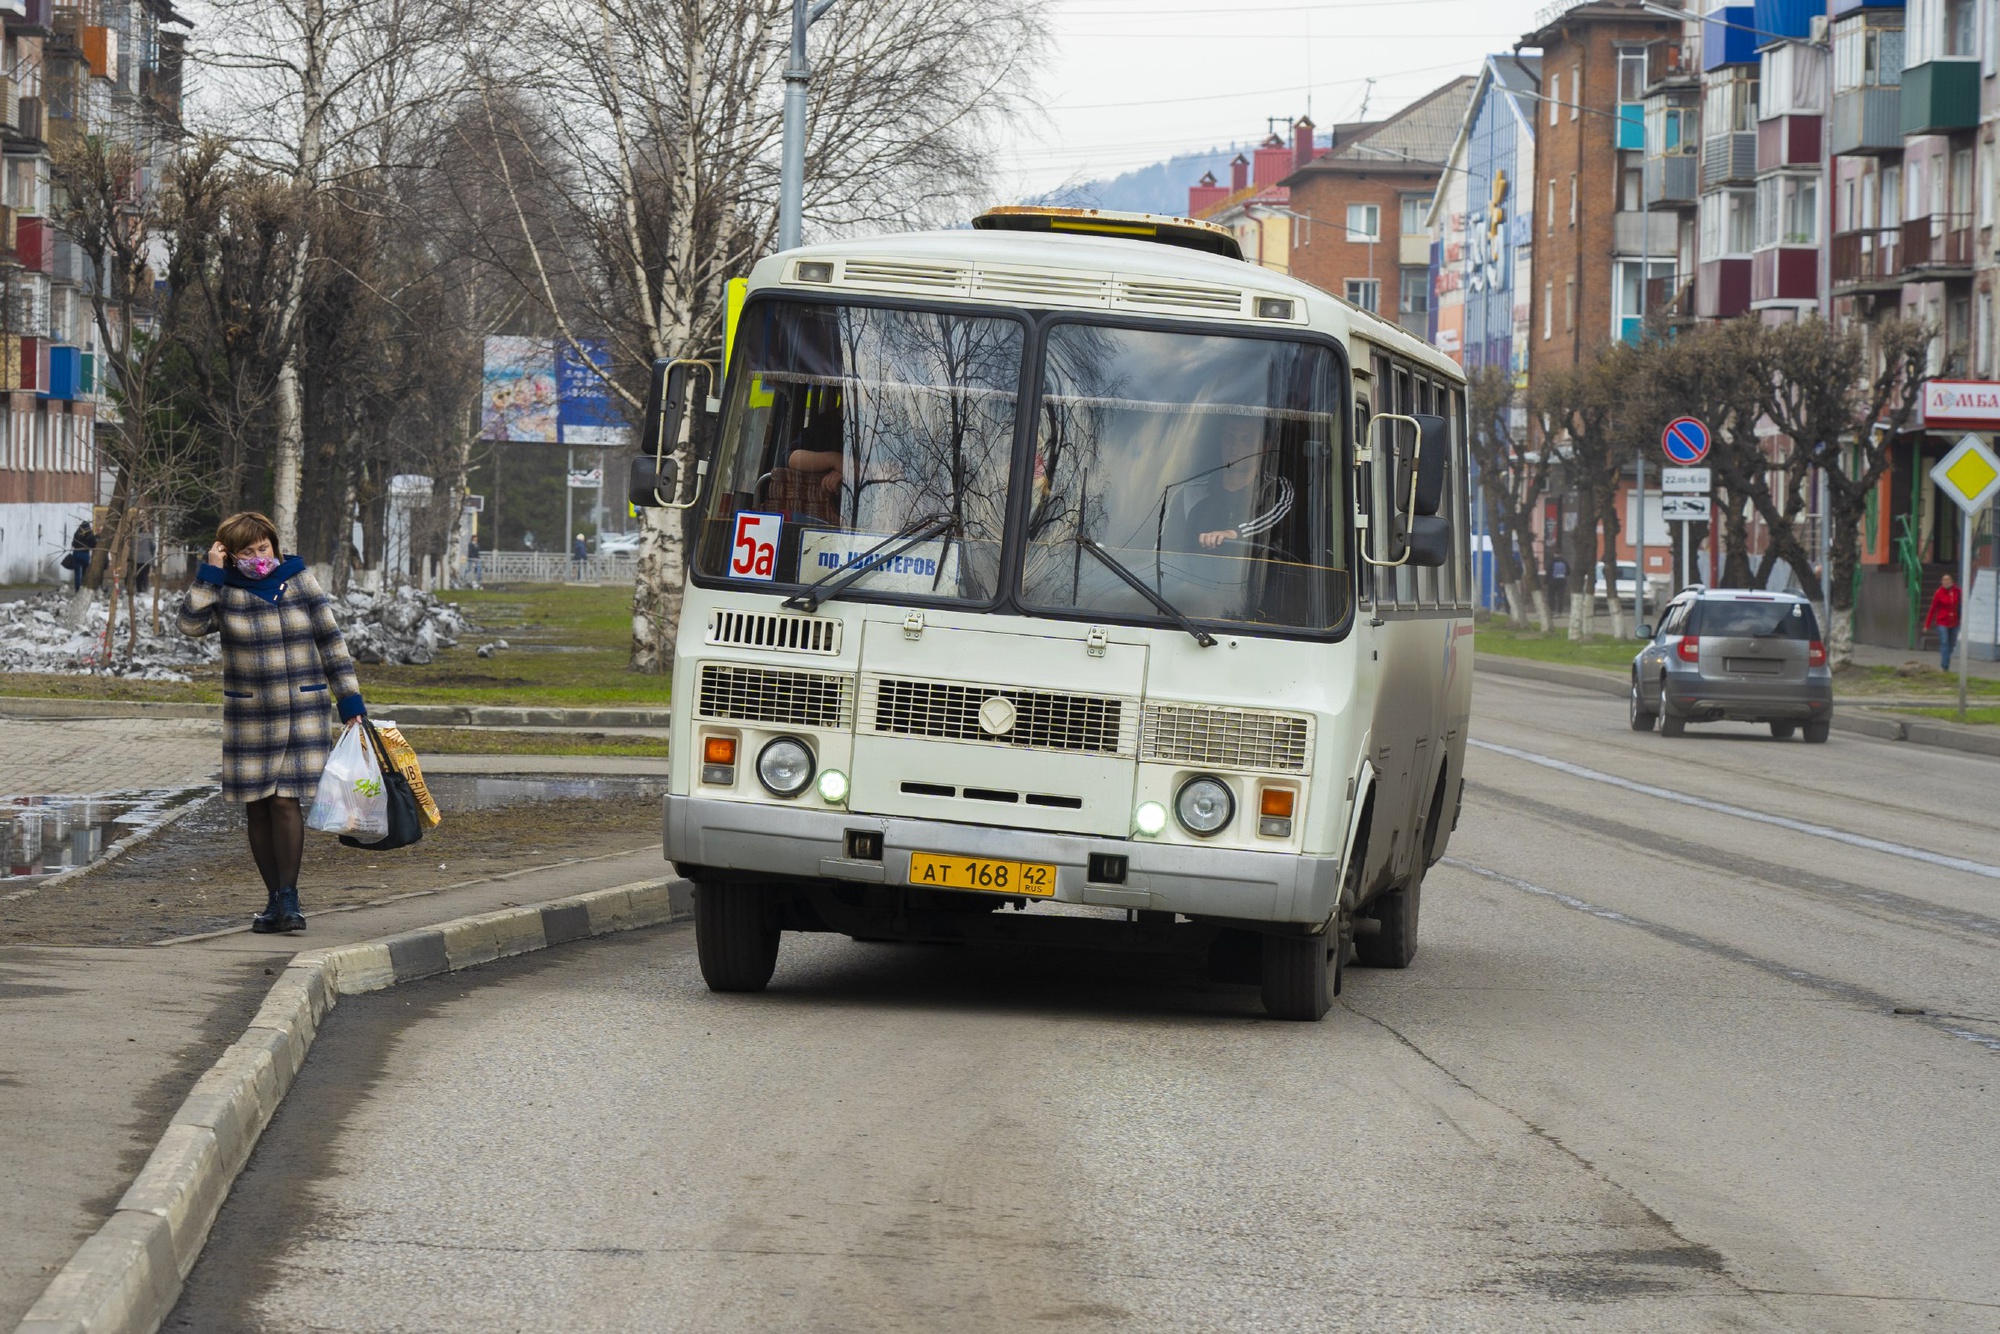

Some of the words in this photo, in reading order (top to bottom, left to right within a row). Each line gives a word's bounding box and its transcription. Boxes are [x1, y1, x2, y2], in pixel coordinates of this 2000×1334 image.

[732, 516, 775, 577] 5а
[818, 552, 842, 570] пр.
[397, 752, 416, 766] POP
[922, 863, 952, 882] АТ
[965, 862, 1009, 887] 168
[1023, 867, 1047, 885] 42
[1025, 884, 1043, 893] RUS
